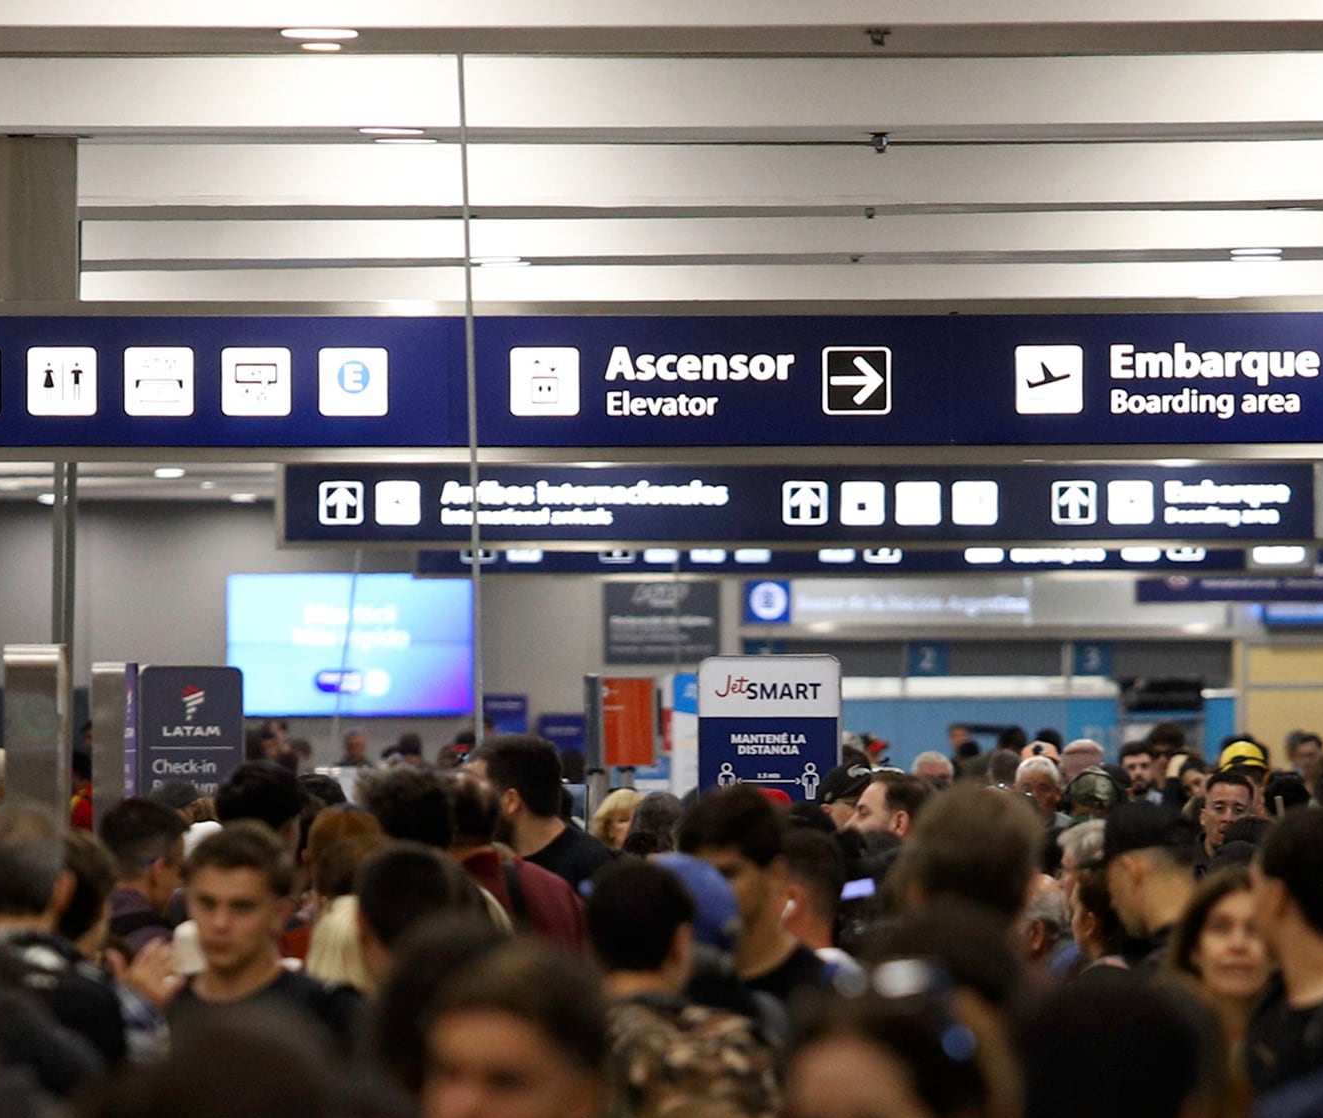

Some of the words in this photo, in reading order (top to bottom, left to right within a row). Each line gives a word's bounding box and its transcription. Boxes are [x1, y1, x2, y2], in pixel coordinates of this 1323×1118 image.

[605, 346, 795, 381] Ascensor
[1110, 342, 1320, 386] Embarque
[607, 390, 718, 417] Elevator
[1110, 388, 1234, 420] Boarding
[1241, 393, 1301, 414] area
[918, 647, 936, 669] 2
[162, 725, 221, 737] LATAM
[730, 732, 789, 744] MANTENÉ
[790, 734, 807, 744] LA
[737, 745, 800, 755] DISTANCIA
[152, 758, 216, 775] Check-in
